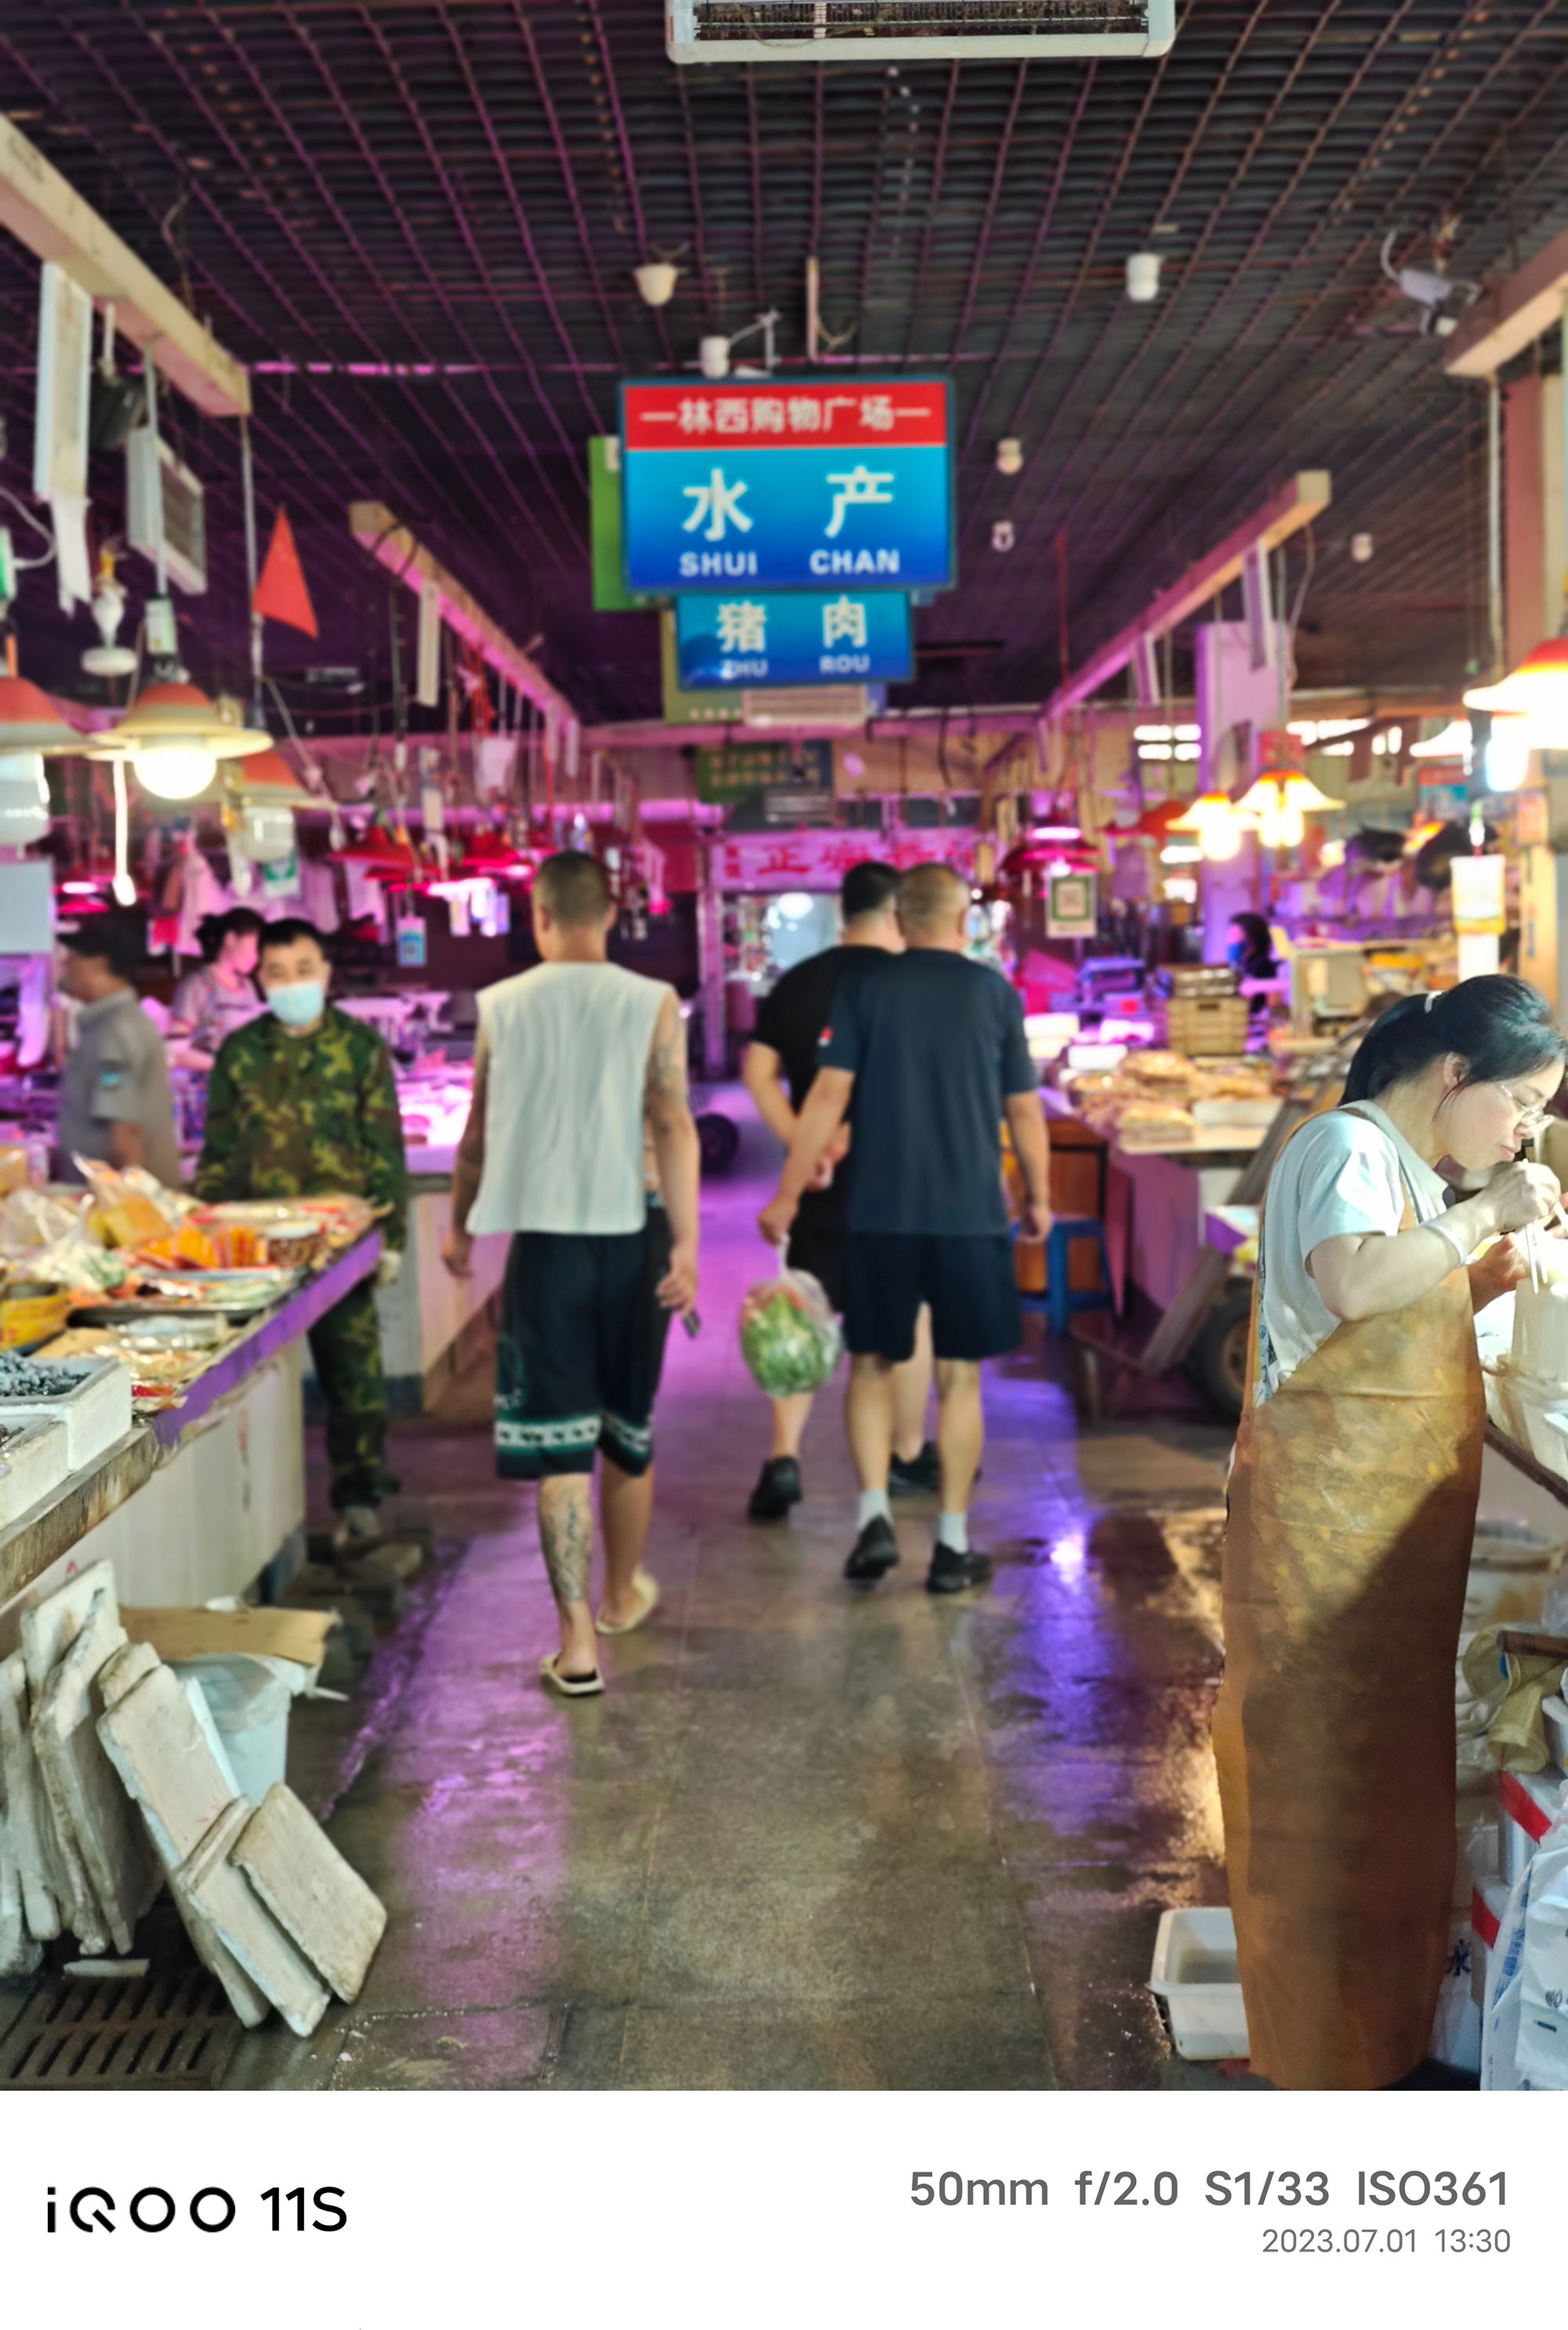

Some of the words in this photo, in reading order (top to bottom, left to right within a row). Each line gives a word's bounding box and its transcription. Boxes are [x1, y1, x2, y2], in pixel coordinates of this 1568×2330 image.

[679, 552, 758, 577] SHUI
[809, 550, 900, 575] CHAN
[819, 655, 870, 673] ROU
